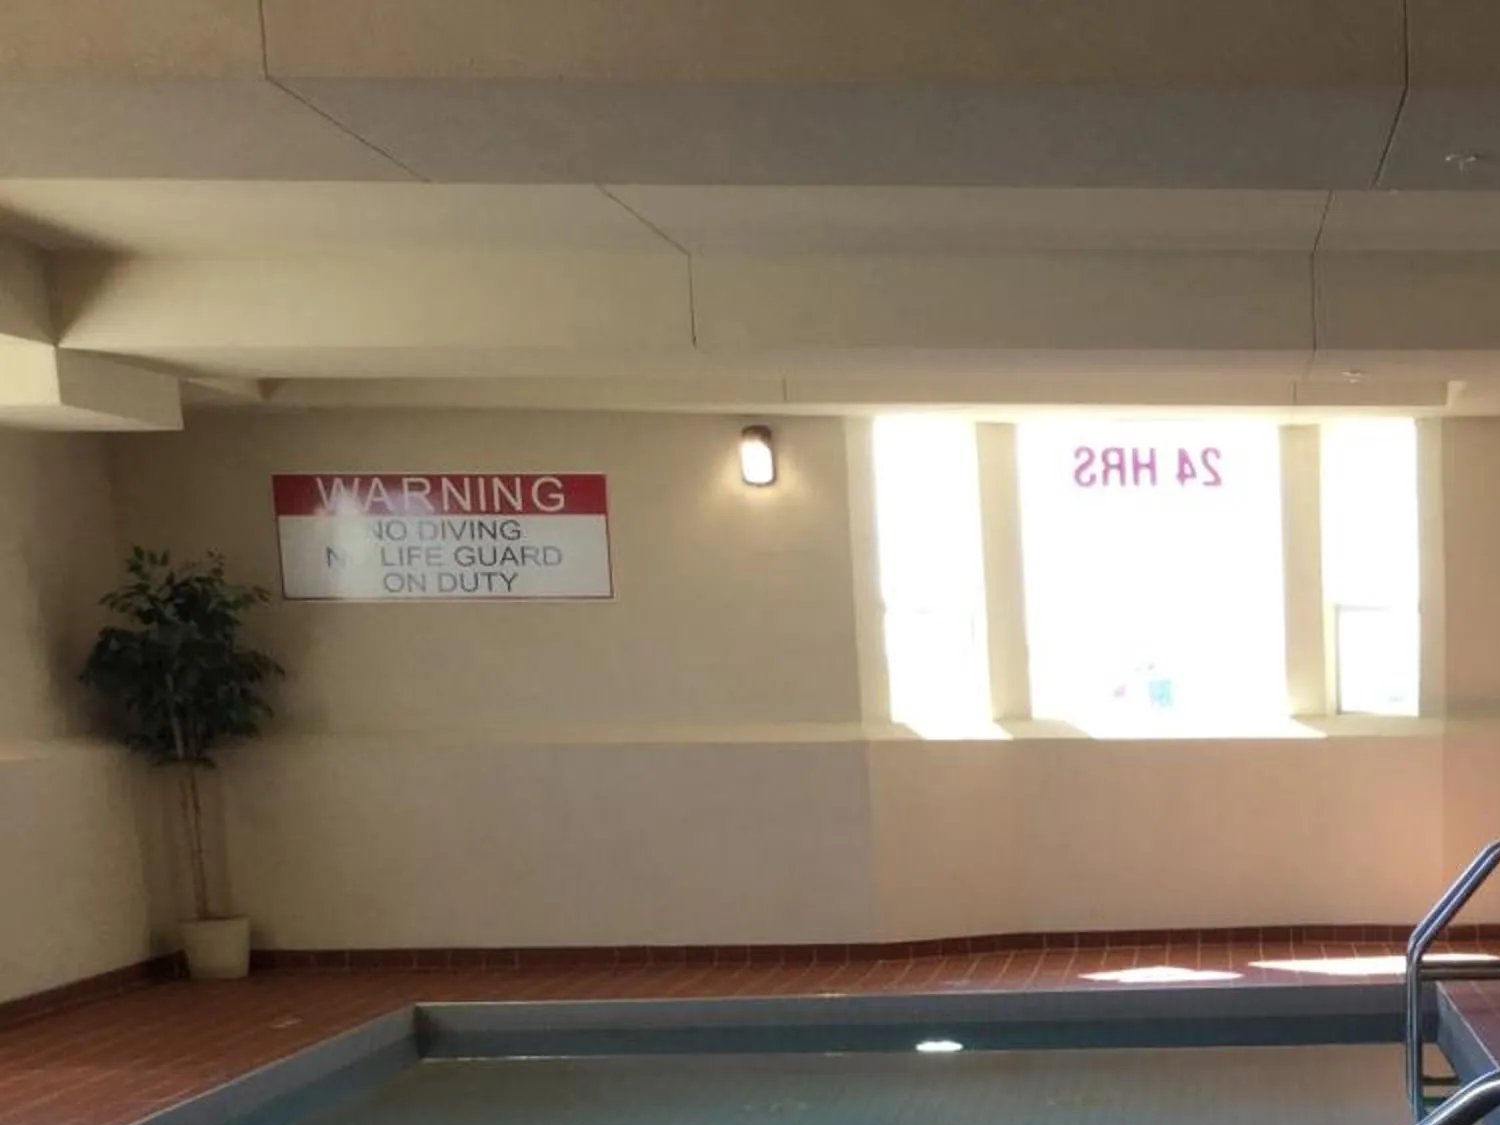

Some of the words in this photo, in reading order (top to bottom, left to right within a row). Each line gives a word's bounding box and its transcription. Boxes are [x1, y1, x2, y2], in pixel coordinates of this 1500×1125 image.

[316, 476, 566, 514] WARNING
[370, 519, 408, 541] NO
[418, 518, 522, 542] DIVING
[380, 546, 445, 568] LIFE
[453, 545, 563, 568] GUARD
[383, 572, 427, 593] ON
[438, 571, 519, 594] DUTY
